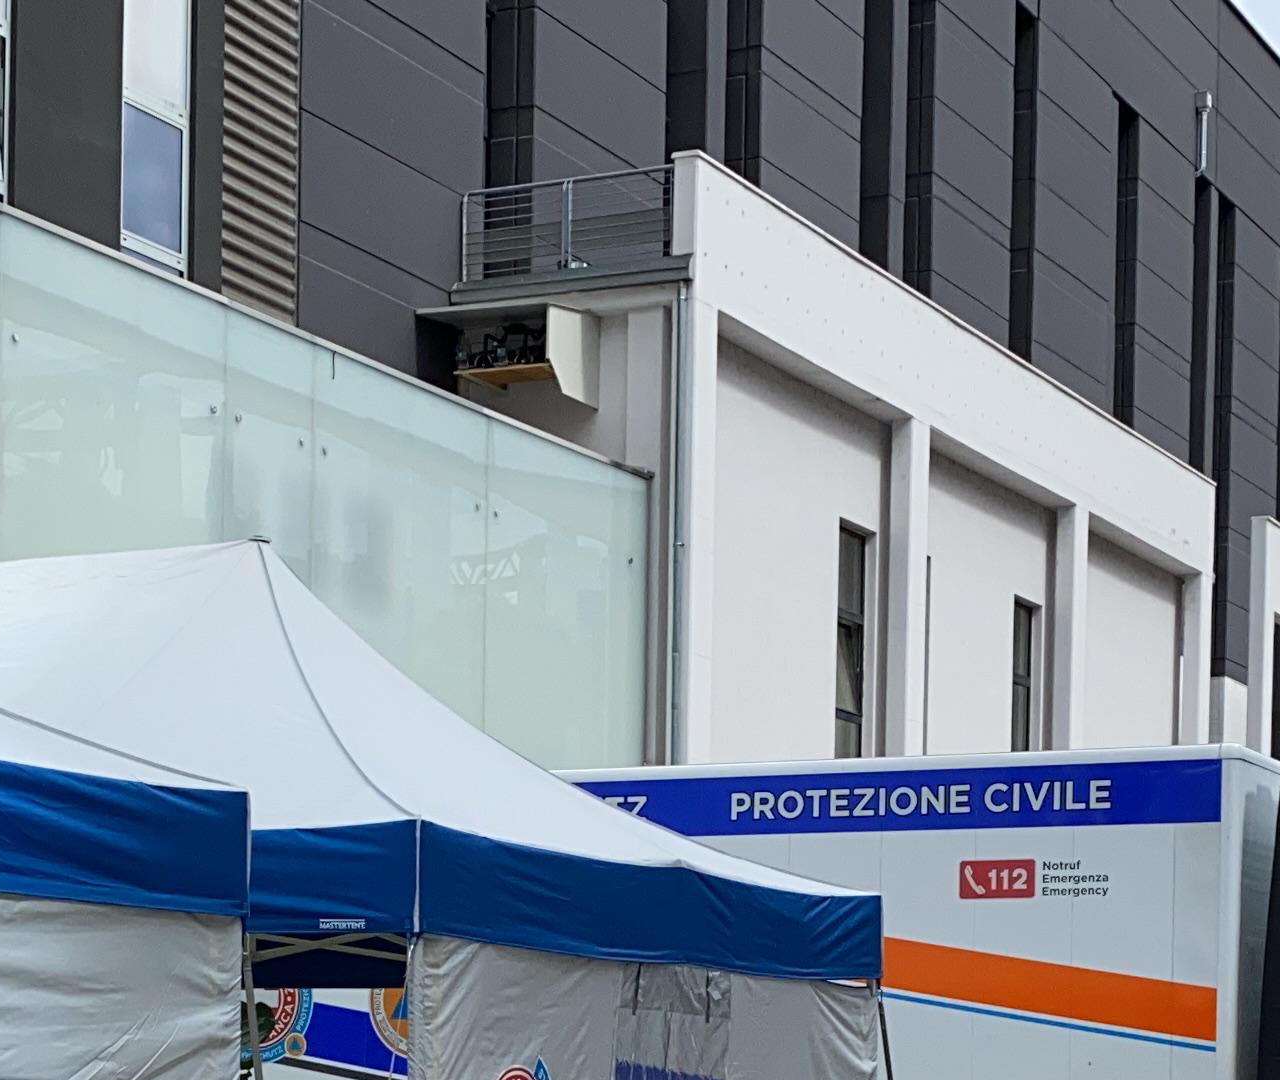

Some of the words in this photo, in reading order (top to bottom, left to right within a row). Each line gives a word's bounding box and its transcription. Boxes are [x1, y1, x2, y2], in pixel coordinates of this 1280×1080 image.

[730, 784, 971, 821] PROTEZIONE
[984, 779, 1112, 812] CIVILE
[1042, 860, 1081, 871] Notruf
[988, 868, 1028, 890] 112
[1042, 873, 1109, 885] Emergenza
[1041, 886, 1109, 897] Emergency
